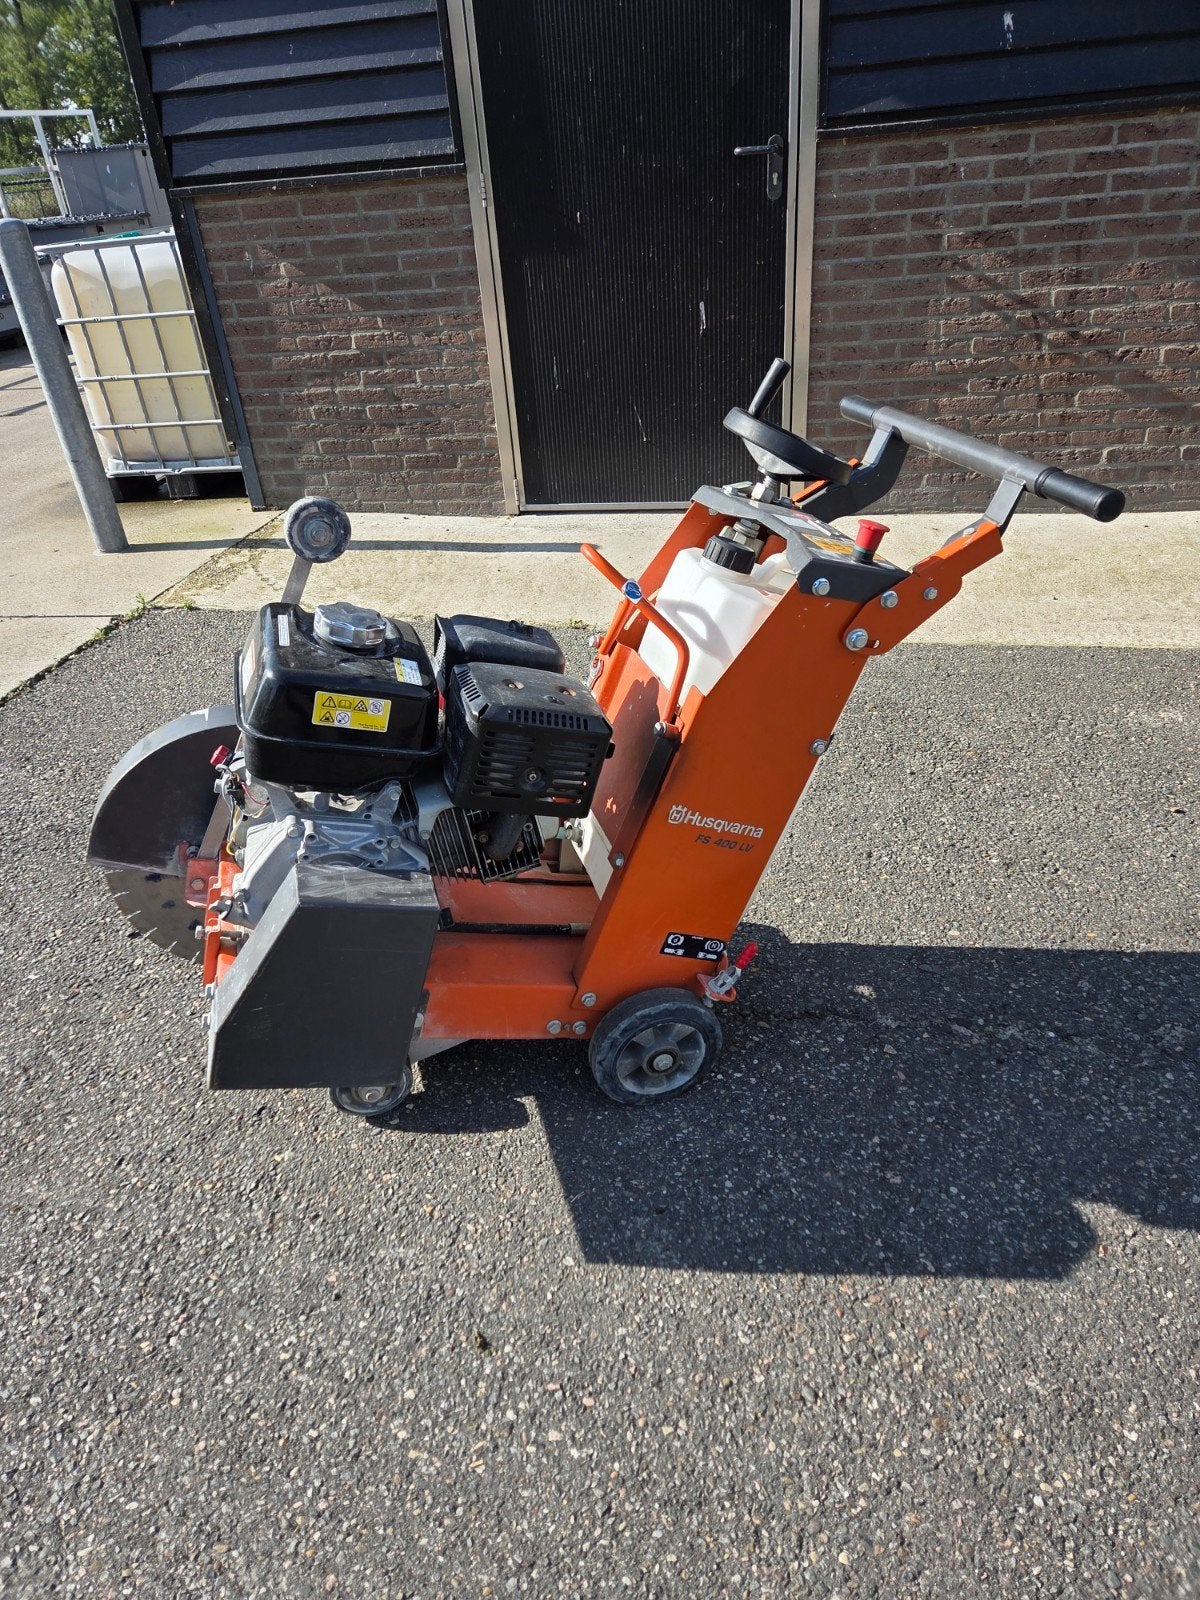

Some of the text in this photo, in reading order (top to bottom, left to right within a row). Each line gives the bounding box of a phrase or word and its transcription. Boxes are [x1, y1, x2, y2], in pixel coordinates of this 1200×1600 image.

[684, 810, 764, 838] Husqvarna
[694, 834, 754, 853] FS 400 LV
